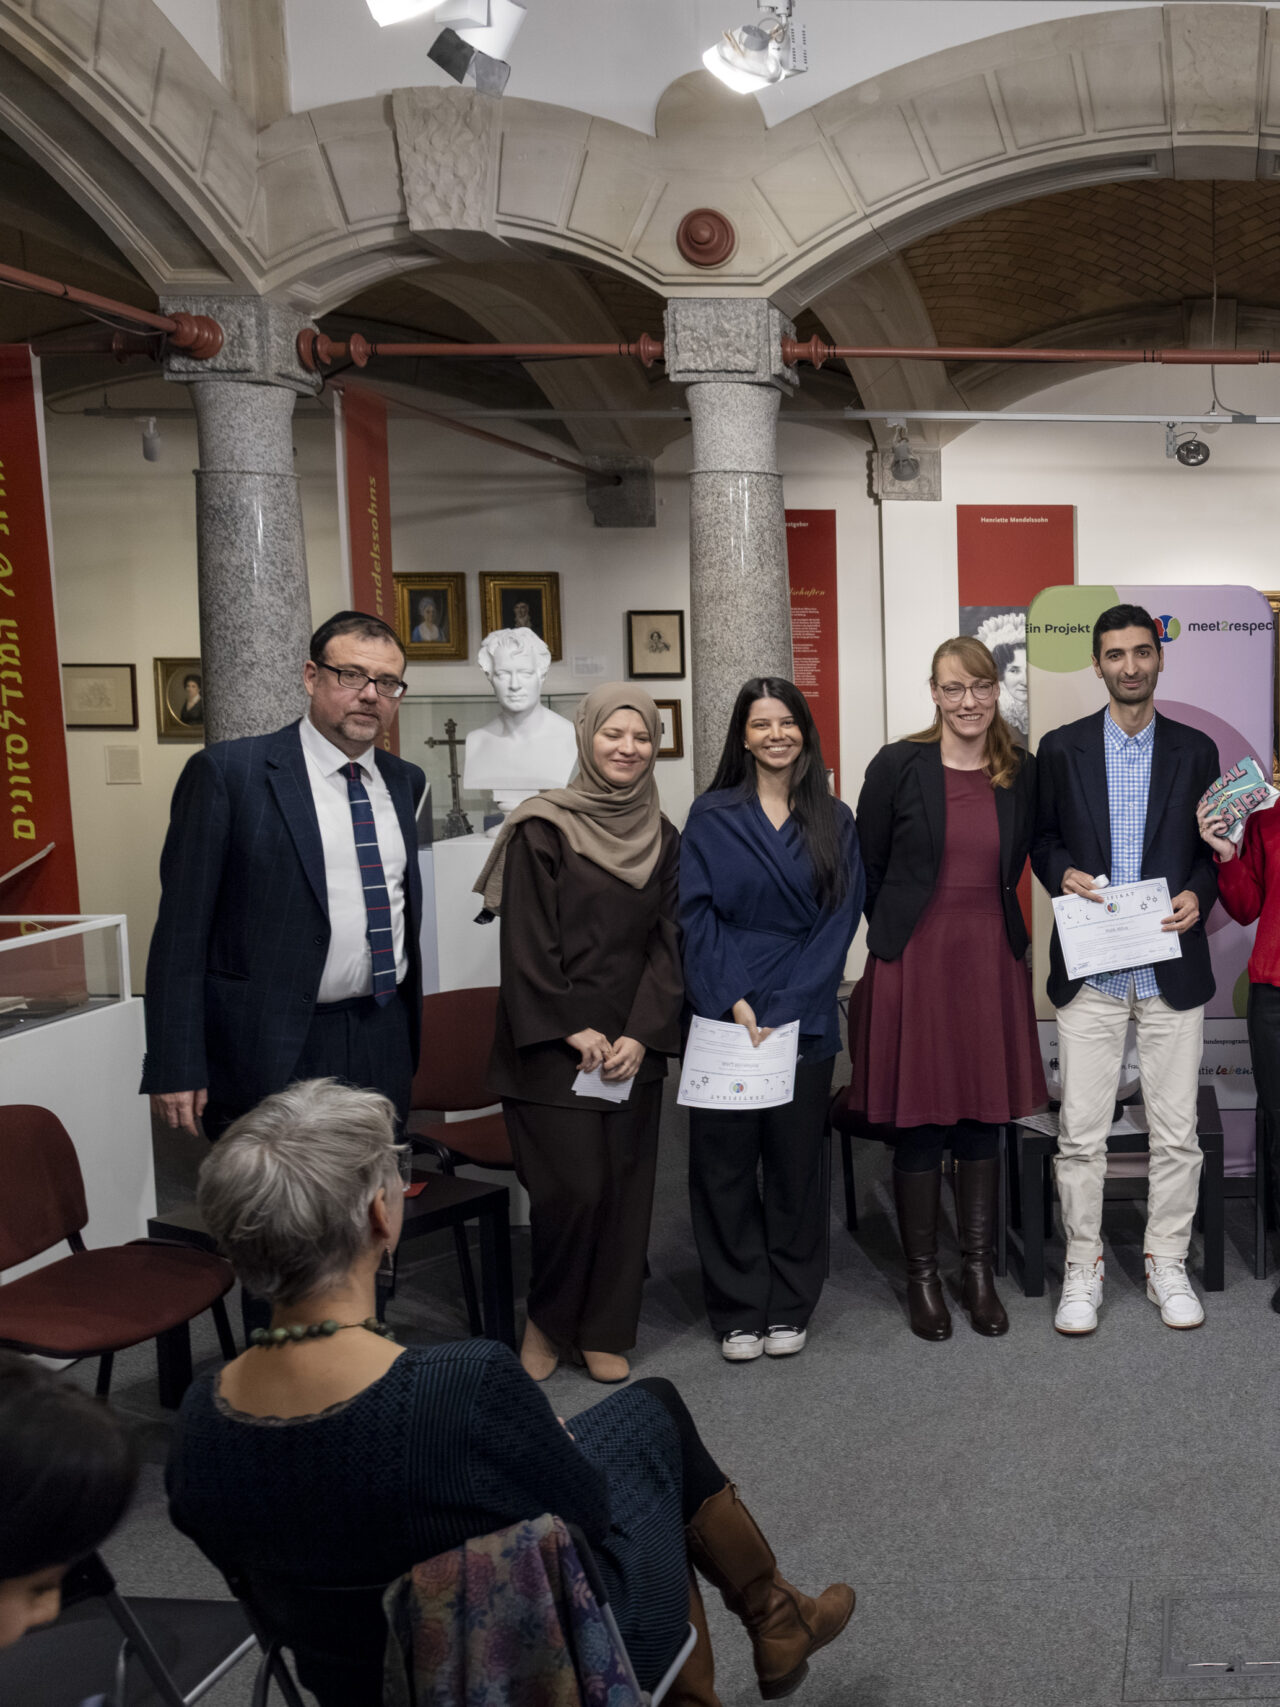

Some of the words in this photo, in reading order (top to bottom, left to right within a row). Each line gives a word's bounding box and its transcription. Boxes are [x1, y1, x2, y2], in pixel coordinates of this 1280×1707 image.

[367, 476, 384, 617] endelssohns
[1044, 623, 1091, 636] Projekt
[1202, 763, 1248, 803] ALAL
[1217, 787, 1270, 830] SHER
